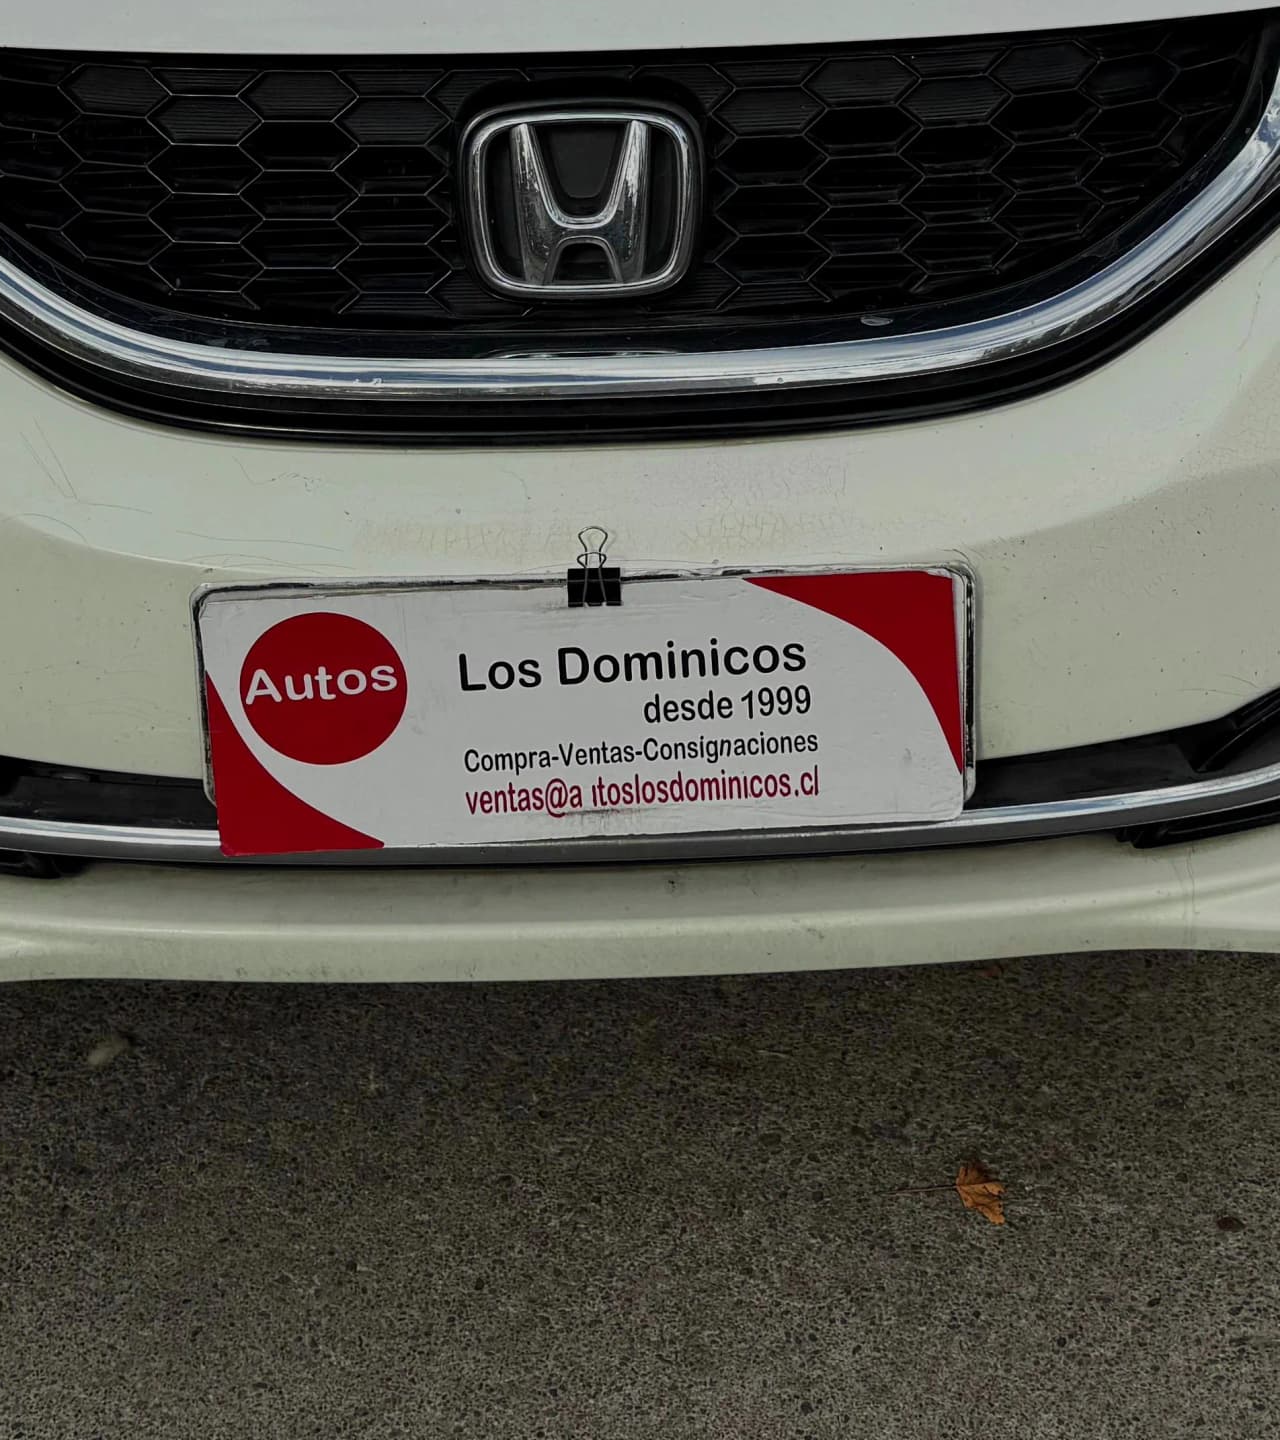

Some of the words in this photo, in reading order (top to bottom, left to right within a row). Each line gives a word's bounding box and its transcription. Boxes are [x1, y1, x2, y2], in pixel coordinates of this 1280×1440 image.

[458, 653, 542, 692] Los
[557, 637, 807, 686] Dominicos
[245, 666, 398, 705] Autos
[643, 689, 734, 724] desde
[740, 684, 811, 720] 1999
[463, 734, 820, 777] Compra-Ventas-Consignaciones
